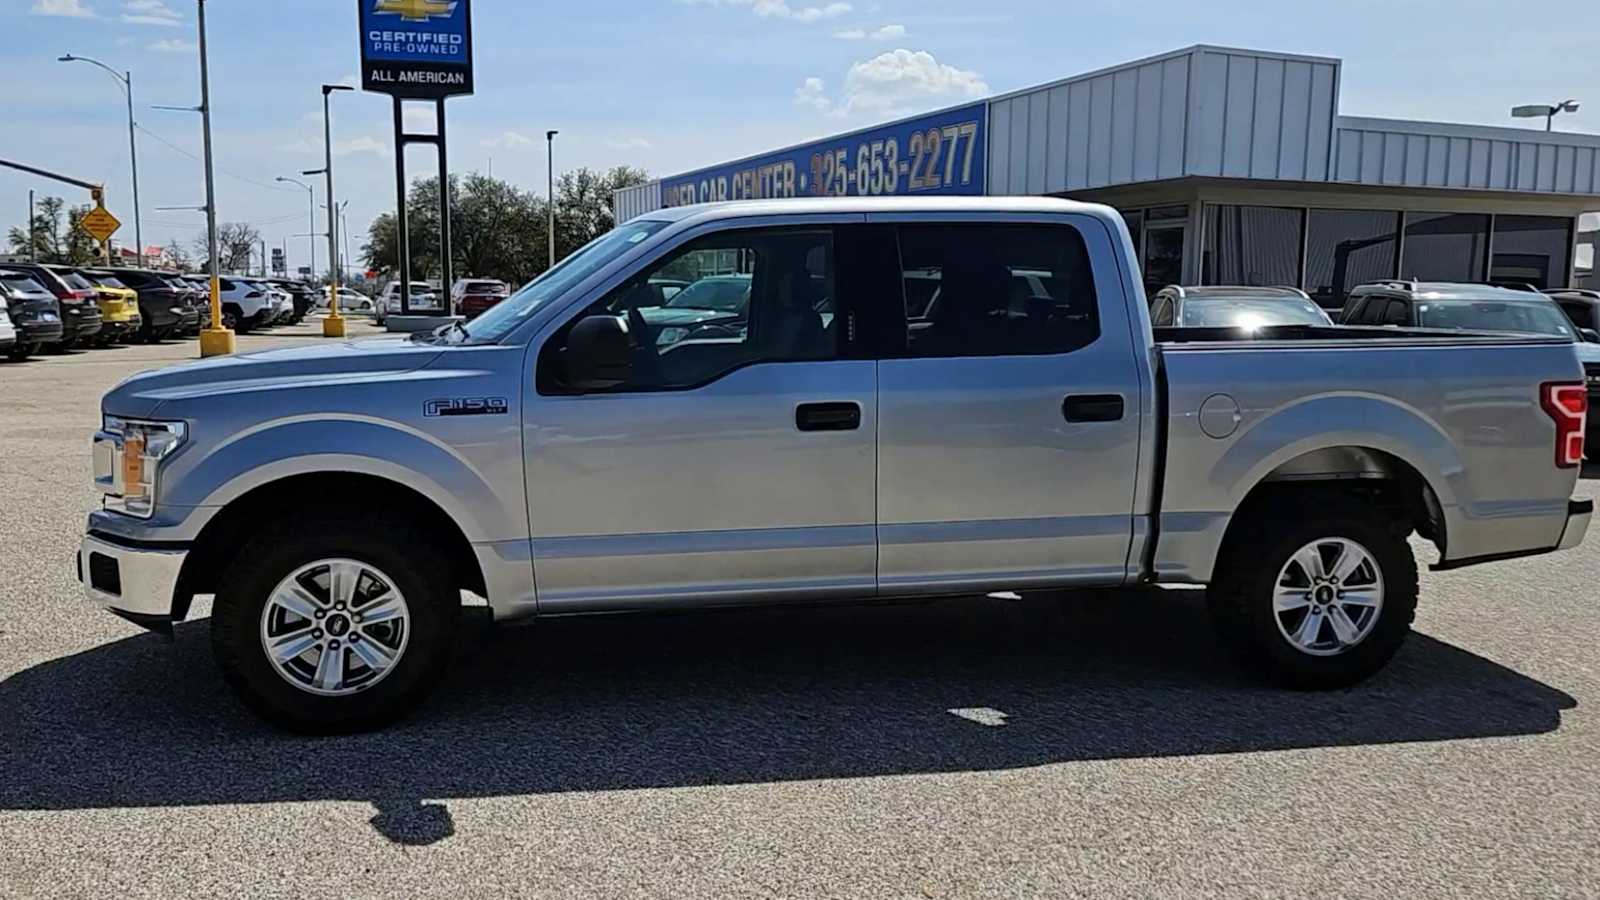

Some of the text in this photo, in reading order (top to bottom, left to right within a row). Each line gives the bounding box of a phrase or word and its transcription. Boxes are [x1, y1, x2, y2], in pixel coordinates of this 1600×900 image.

[369, 31, 462, 44] CERTIFIED
[374, 42, 458, 54] PRE-OWNED
[371, 70, 464, 84] ALL AMERICAN
[700, 177, 727, 203] CAR
[732, 161, 796, 200] CENTER
